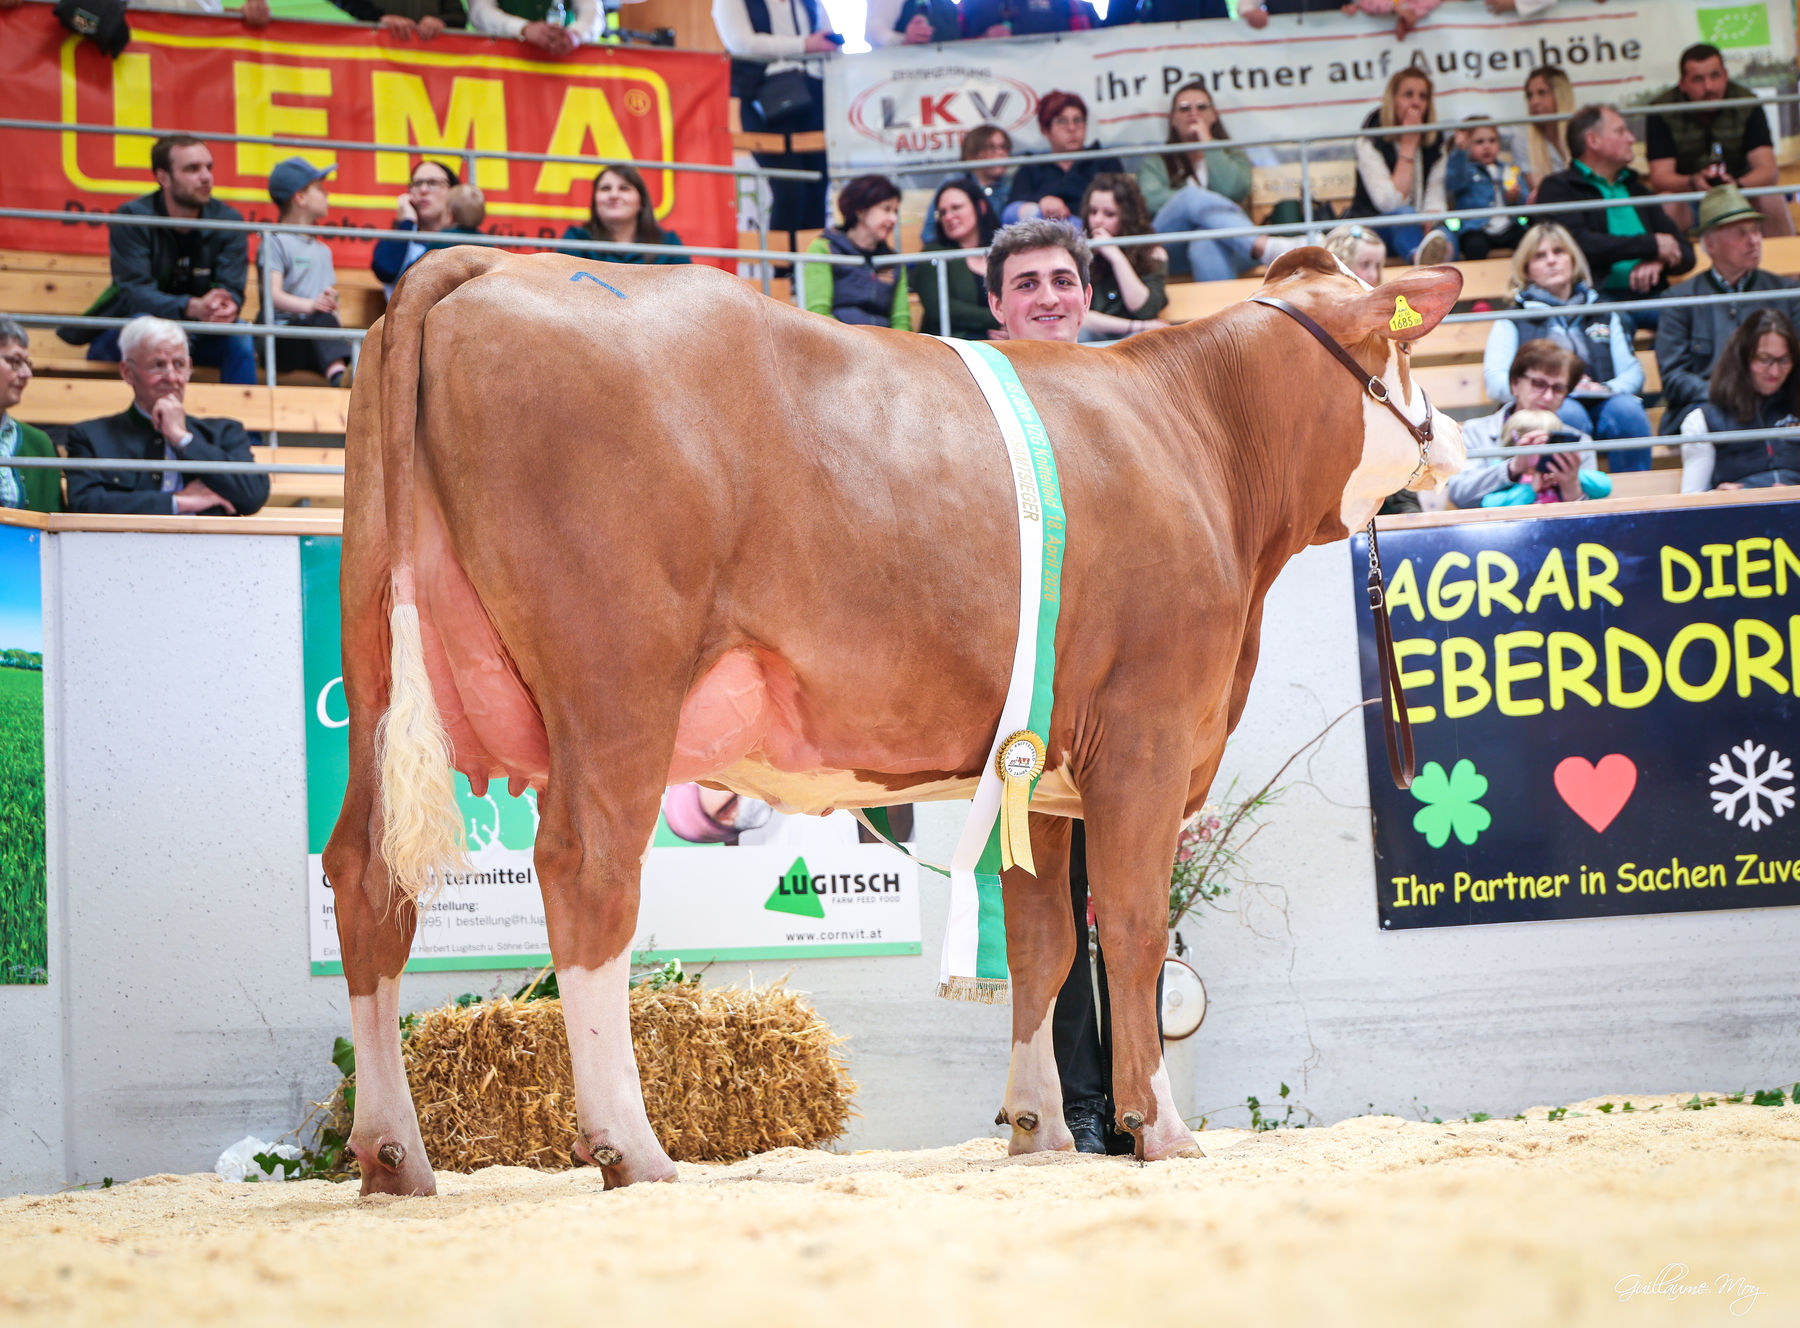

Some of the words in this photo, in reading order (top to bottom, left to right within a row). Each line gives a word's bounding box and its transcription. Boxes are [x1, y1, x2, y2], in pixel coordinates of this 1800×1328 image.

[1095, 70, 1147, 102] Ihr
[1163, 64, 1310, 96] Partner
[1328, 49, 1393, 84] auf
[1407, 34, 1643, 80] Augenhöhe
[880, 90, 1012, 130] LKV
[112, 52, 640, 195] LEMA
[895, 128, 964, 154] AUST
[1392, 316, 1413, 329] 1685
[1043, 533, 1063, 571] April
[1385, 542, 1625, 622] AGRAR
[1660, 537, 1800, 605] DIEN
[443, 867, 532, 886] termittel
[778, 873, 901, 896] LUGITSCH
[1391, 874, 1445, 908] Ihr
[1454, 870, 1569, 903] Partner
[1579, 864, 1607, 896] in
[1616, 857, 1728, 893] Sachen
[1734, 853, 1800, 886] Zuve
[831, 896, 854, 904] FARM
[857, 896, 877, 904] FEED
[879, 895, 901, 903] FOOD
[456, 914, 547, 928] bestellung@h.lug
[785, 928, 883, 942] www.cornvit.at
